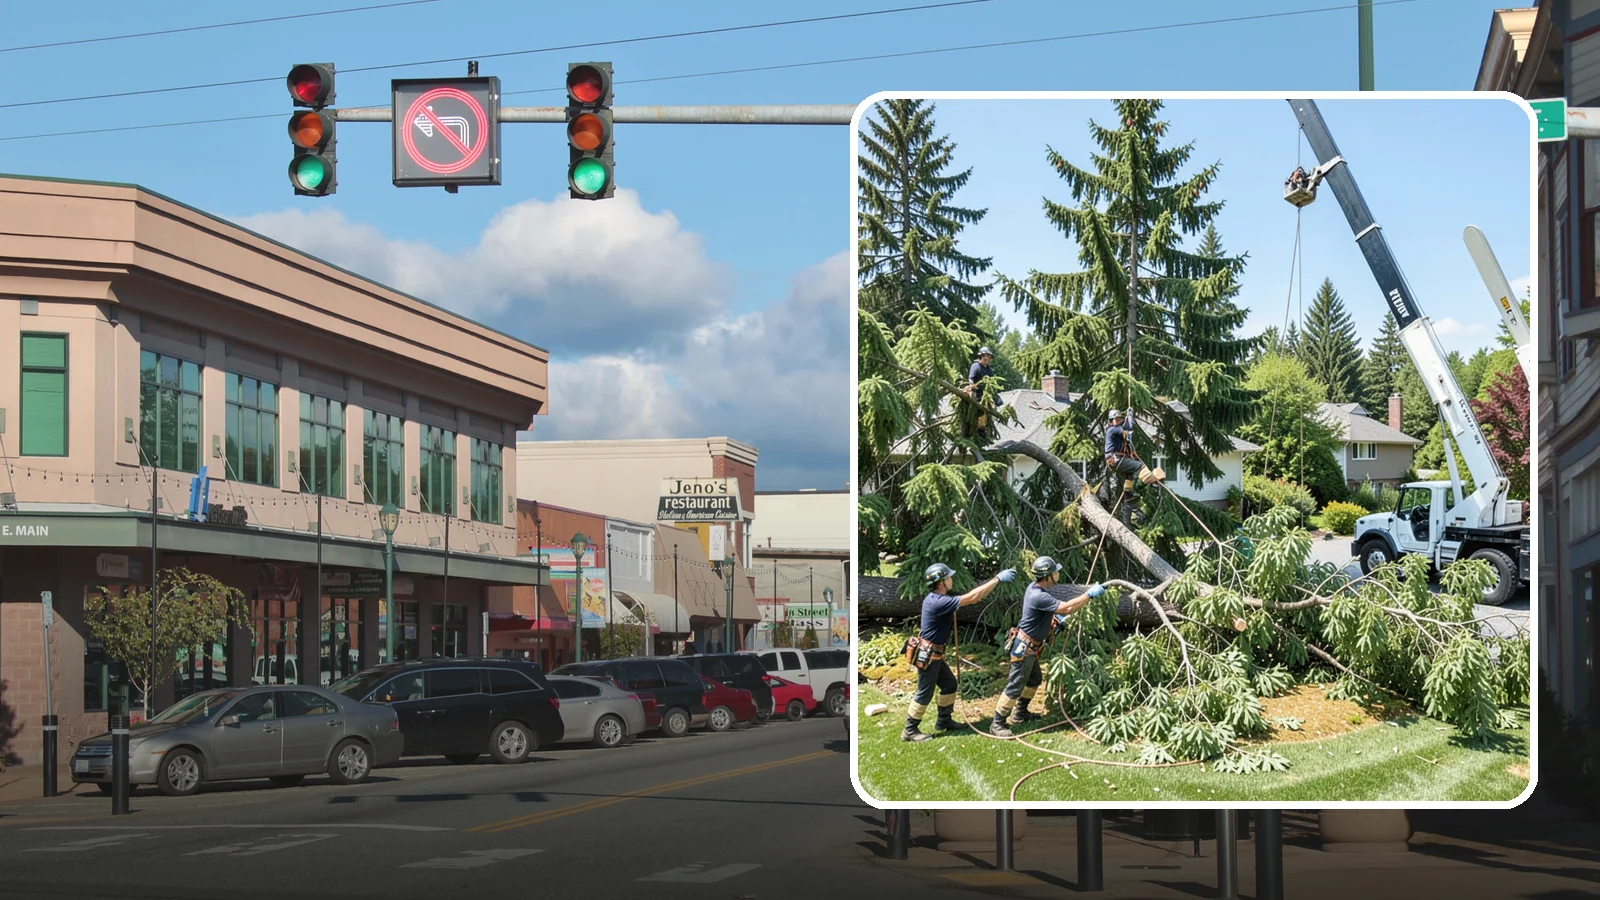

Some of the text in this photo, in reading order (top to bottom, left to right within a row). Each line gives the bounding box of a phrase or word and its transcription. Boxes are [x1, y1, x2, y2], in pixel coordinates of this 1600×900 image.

[670, 480, 727, 494] Jeno's
[665, 497, 731, 509] restaurant
[659, 510, 681, 519] Italian
[686, 509, 714, 519] American
[715, 509, 737, 519] Cuisine
[2, 525, 49, 536] E. MAIN
[797, 608, 828, 616] Street
